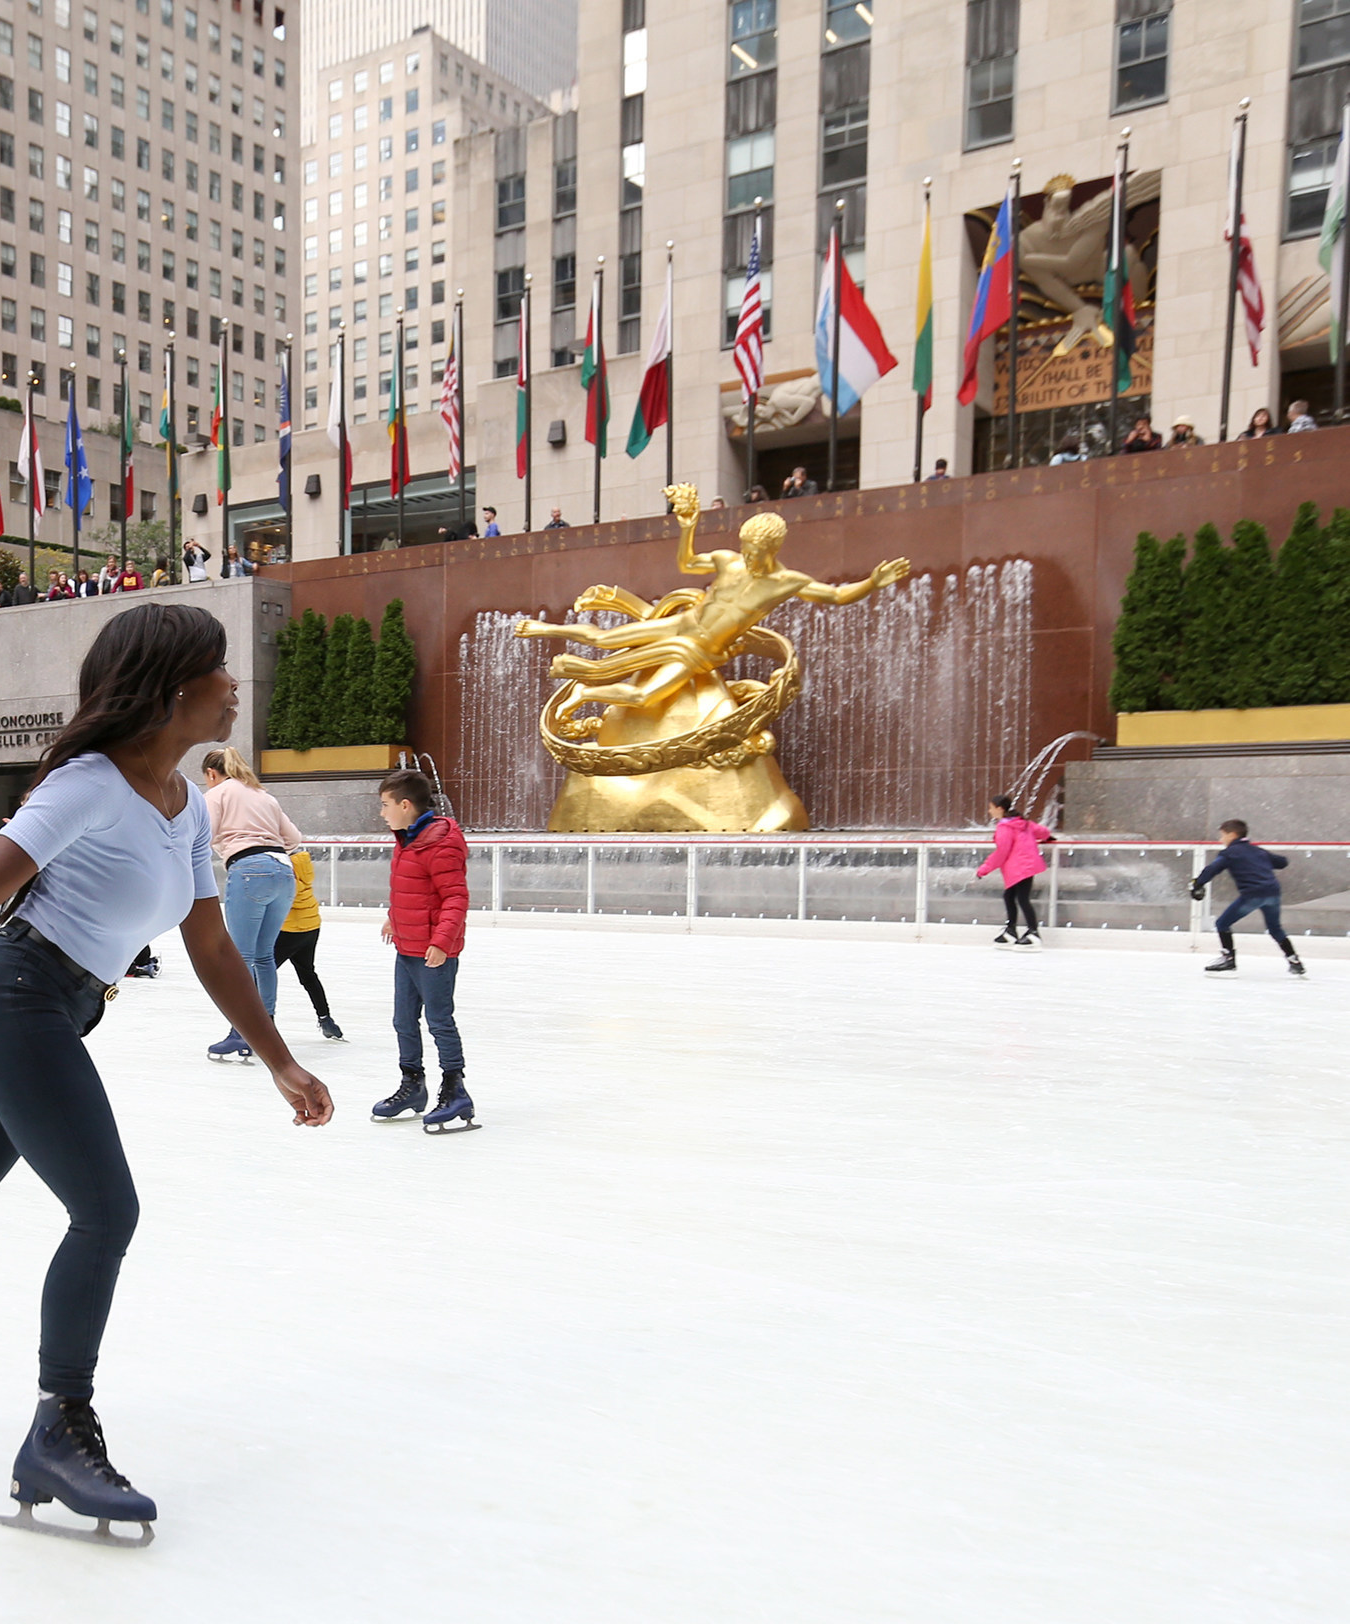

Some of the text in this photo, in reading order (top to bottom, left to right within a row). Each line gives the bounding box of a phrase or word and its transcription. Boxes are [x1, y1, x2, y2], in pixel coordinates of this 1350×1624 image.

[1041, 364, 1103, 386] SHALL BE
[1068, 382, 1089, 399] OF
[479, 543, 566, 560] PROVED
[593, 535, 617, 546] TO
[835, 498, 928, 517] MEANS
[512, 526, 617, 545] TEACHER
[815, 493, 863, 508] ART
